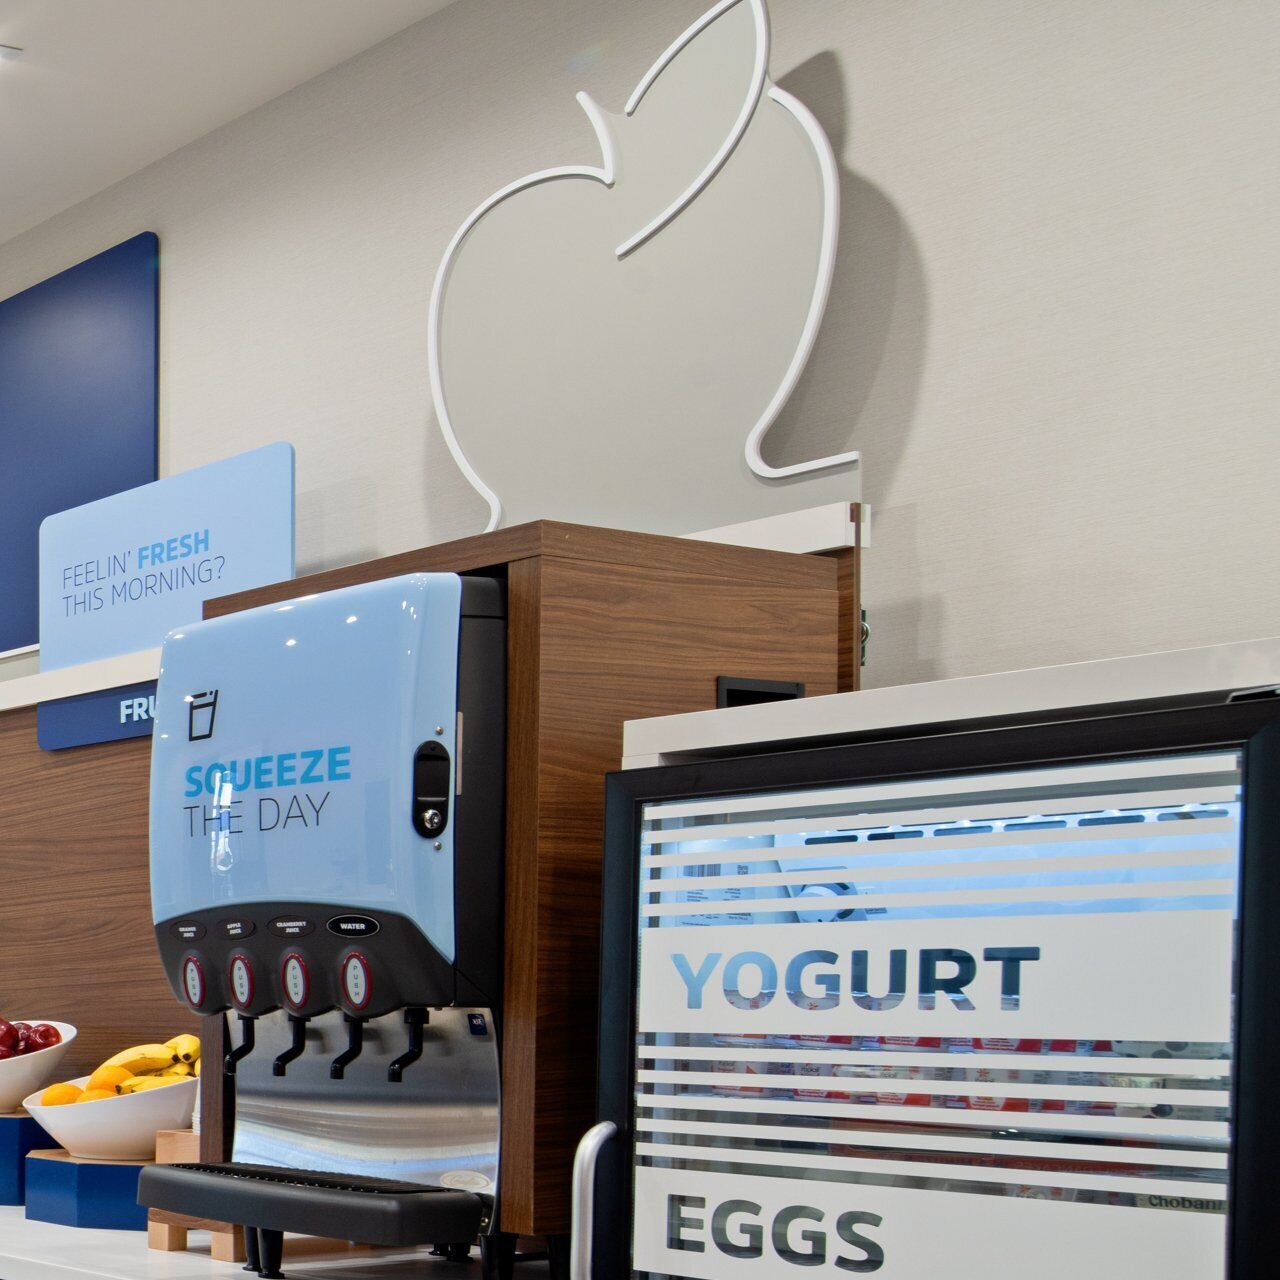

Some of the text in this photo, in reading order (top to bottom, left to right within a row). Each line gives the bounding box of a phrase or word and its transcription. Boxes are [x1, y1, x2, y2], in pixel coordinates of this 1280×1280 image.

[62, 555, 226, 617] THIS MORNING?
[63, 528, 210, 590] FEELIN' FRESH
[184, 745, 351, 798] SQUEEZE
[183, 791, 330, 838] THE DAY
[340, 922, 366, 930] WATER
[237, 966, 245, 996] PUSH
[670, 946, 1040, 1012] YOGURT
[666, 1193, 885, 1274] EGGS
